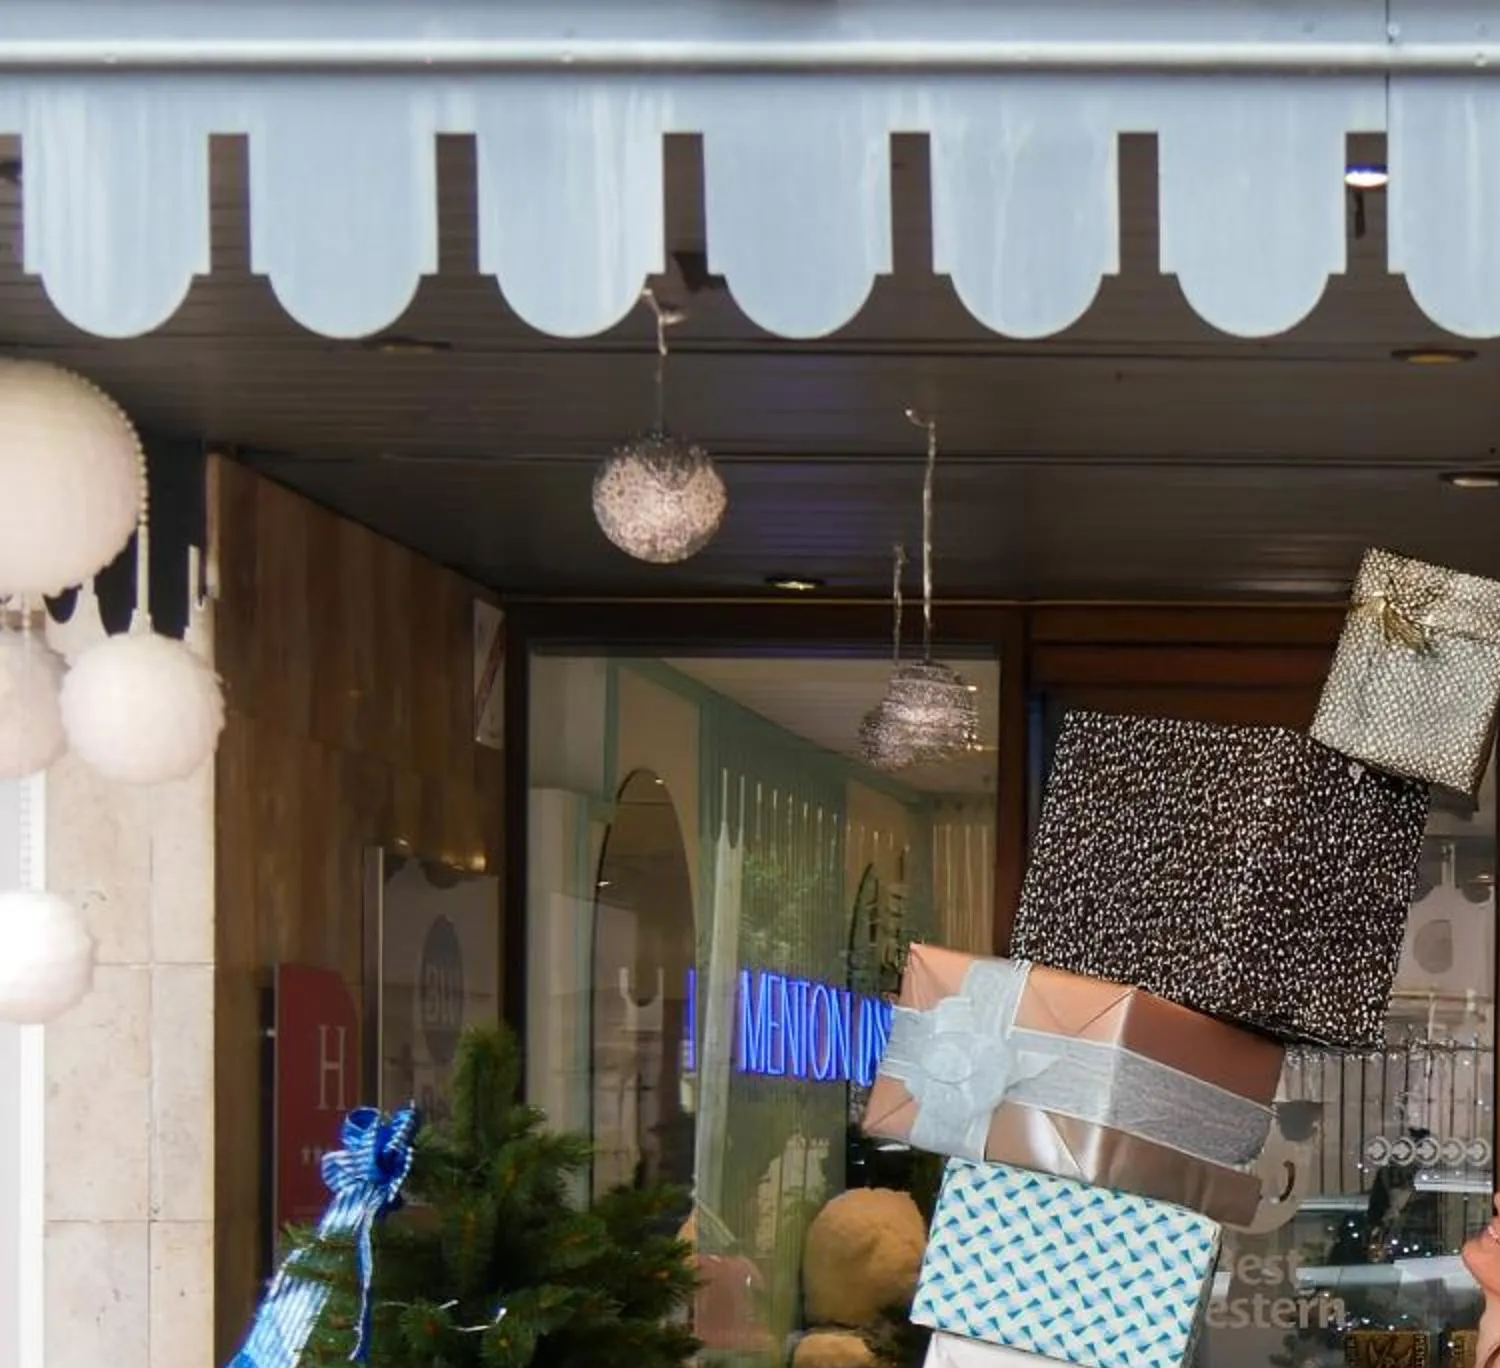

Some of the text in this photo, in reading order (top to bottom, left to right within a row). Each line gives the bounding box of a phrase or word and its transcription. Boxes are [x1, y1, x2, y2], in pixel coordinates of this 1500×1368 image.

[315, 1025, 347, 1110] H
[741, 970, 851, 1080] MENTON
[1205, 1292, 1346, 1330] estern
